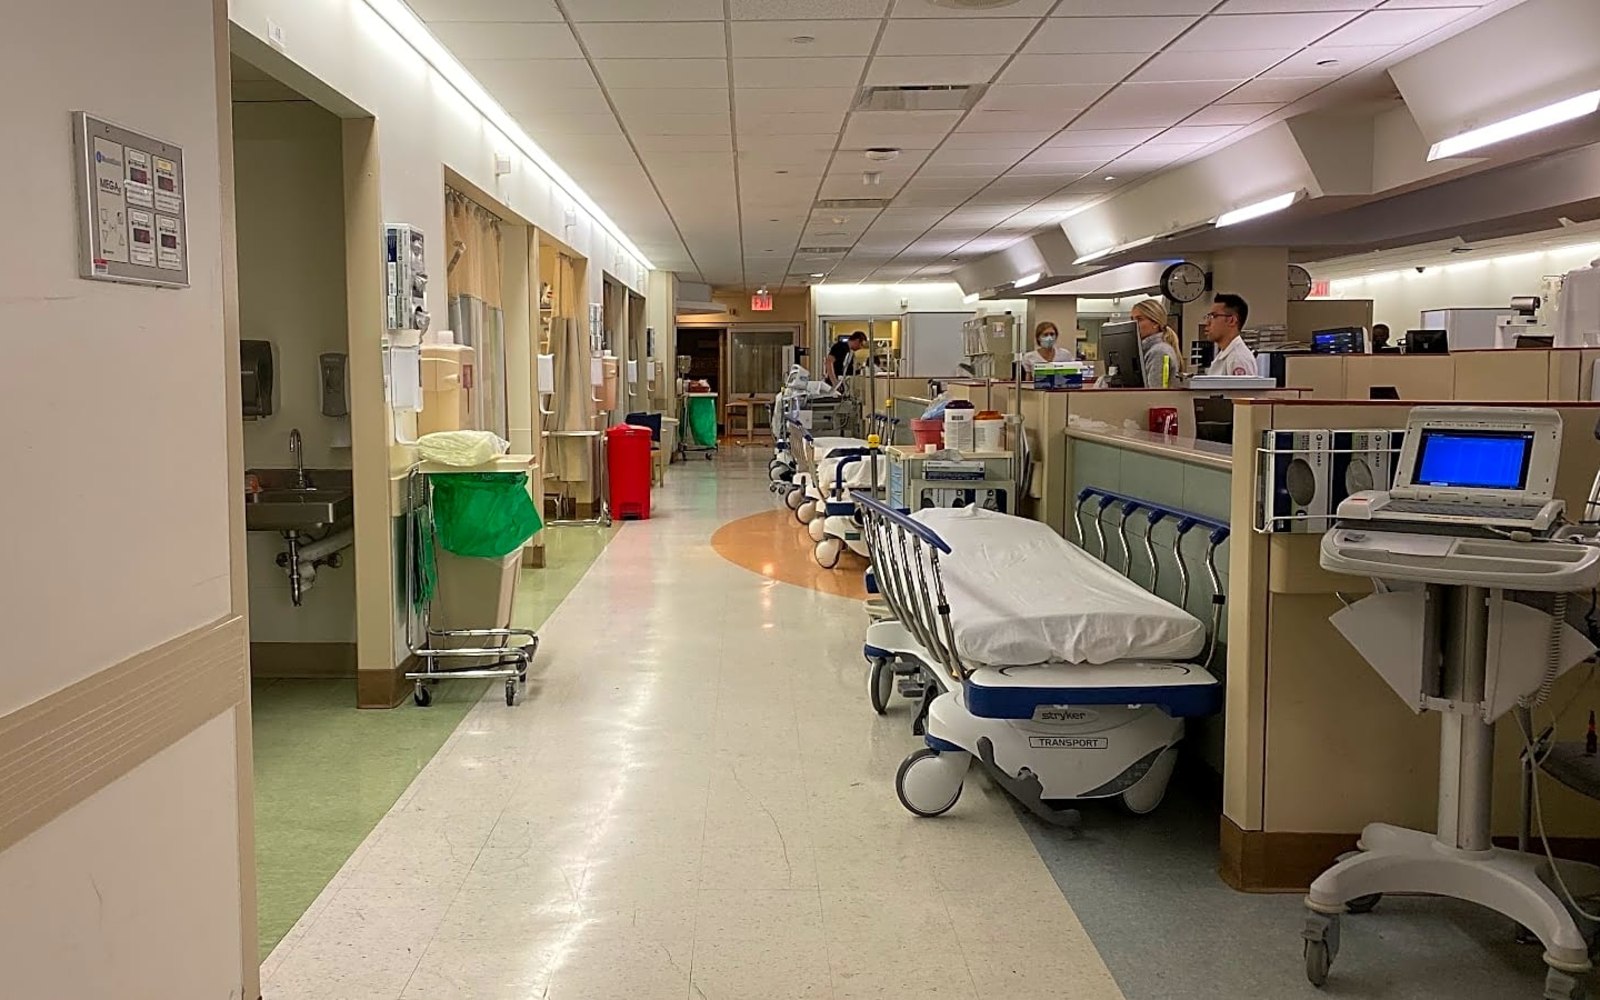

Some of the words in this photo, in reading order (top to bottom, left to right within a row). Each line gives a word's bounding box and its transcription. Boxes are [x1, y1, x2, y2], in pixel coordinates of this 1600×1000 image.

[754, 296, 770, 309] EXIT
[1041, 710, 1086, 720] stryker
[1039, 739, 1098, 747] TRANSPORT
